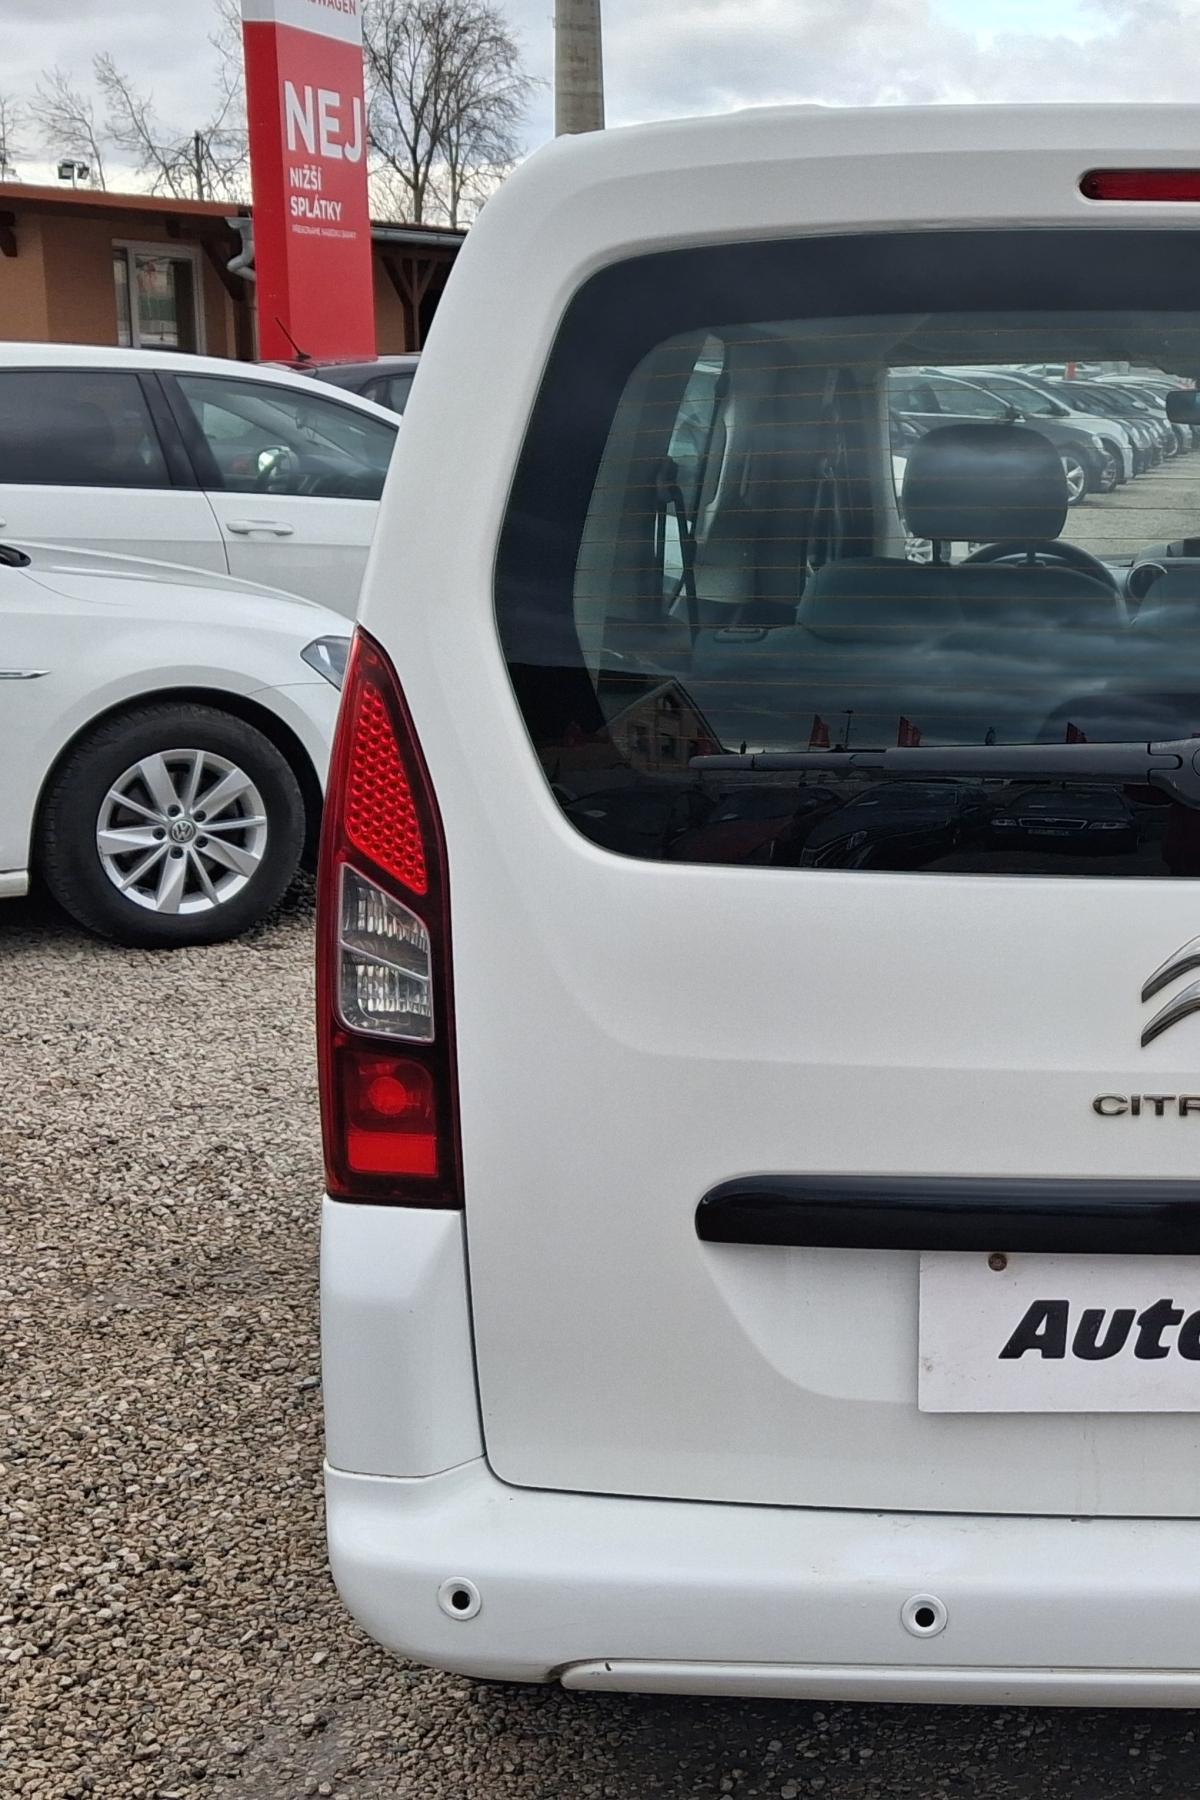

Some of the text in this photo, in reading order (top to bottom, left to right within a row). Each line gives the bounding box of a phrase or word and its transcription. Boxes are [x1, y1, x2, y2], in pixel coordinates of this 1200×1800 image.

[284, 80, 362, 163] NEJ
[289, 164, 322, 191] NIŽŠÍ
[290, 194, 341, 221] SPLÁTKY
